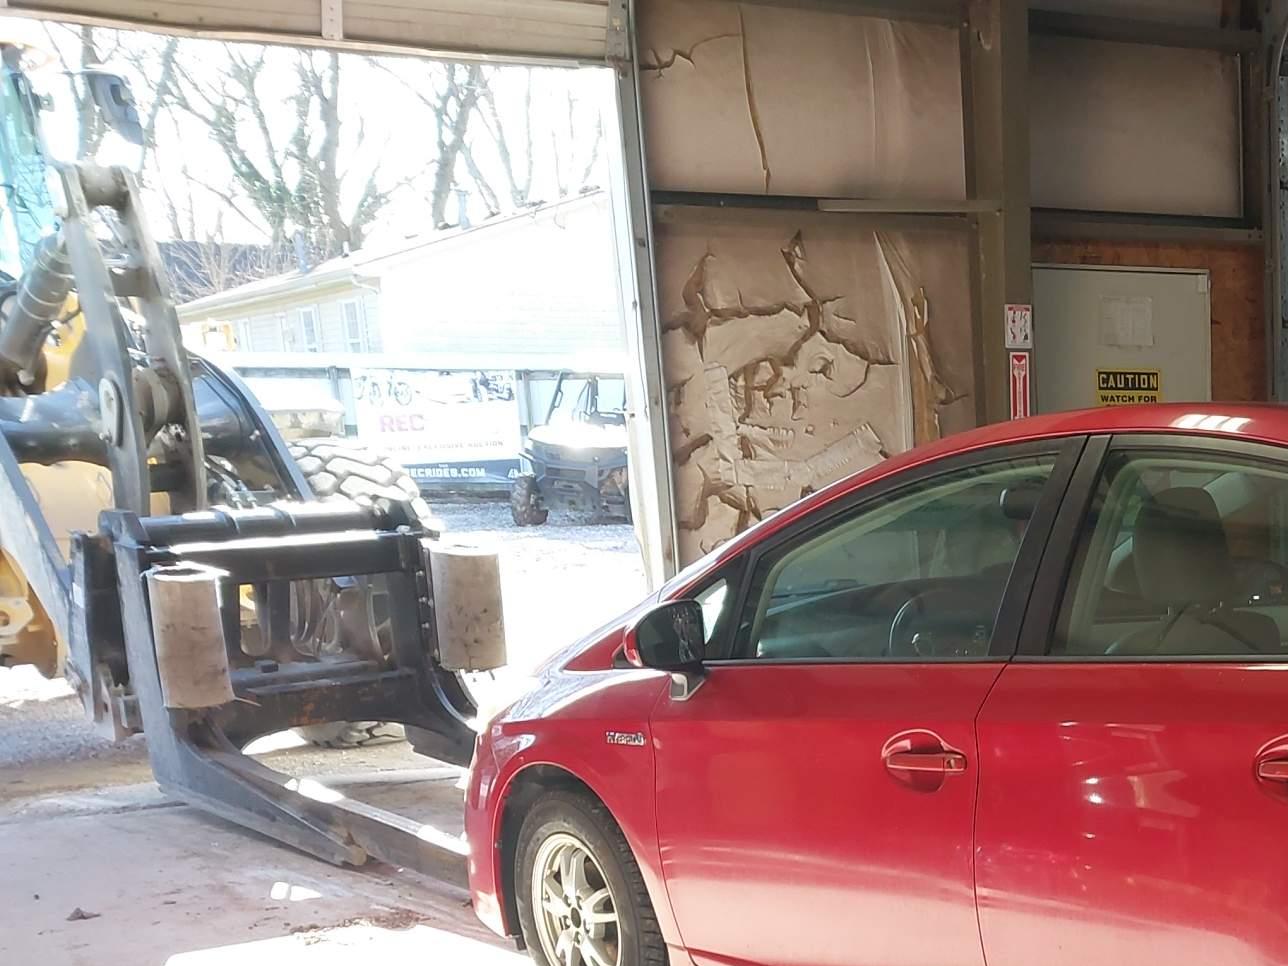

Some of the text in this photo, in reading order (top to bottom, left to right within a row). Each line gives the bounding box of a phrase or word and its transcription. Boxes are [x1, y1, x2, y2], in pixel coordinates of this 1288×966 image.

[1099, 373, 1158, 389] CAUTION
[1100, 395, 1157, 403] WATCH FOR
[380, 415, 425, 432] REC
